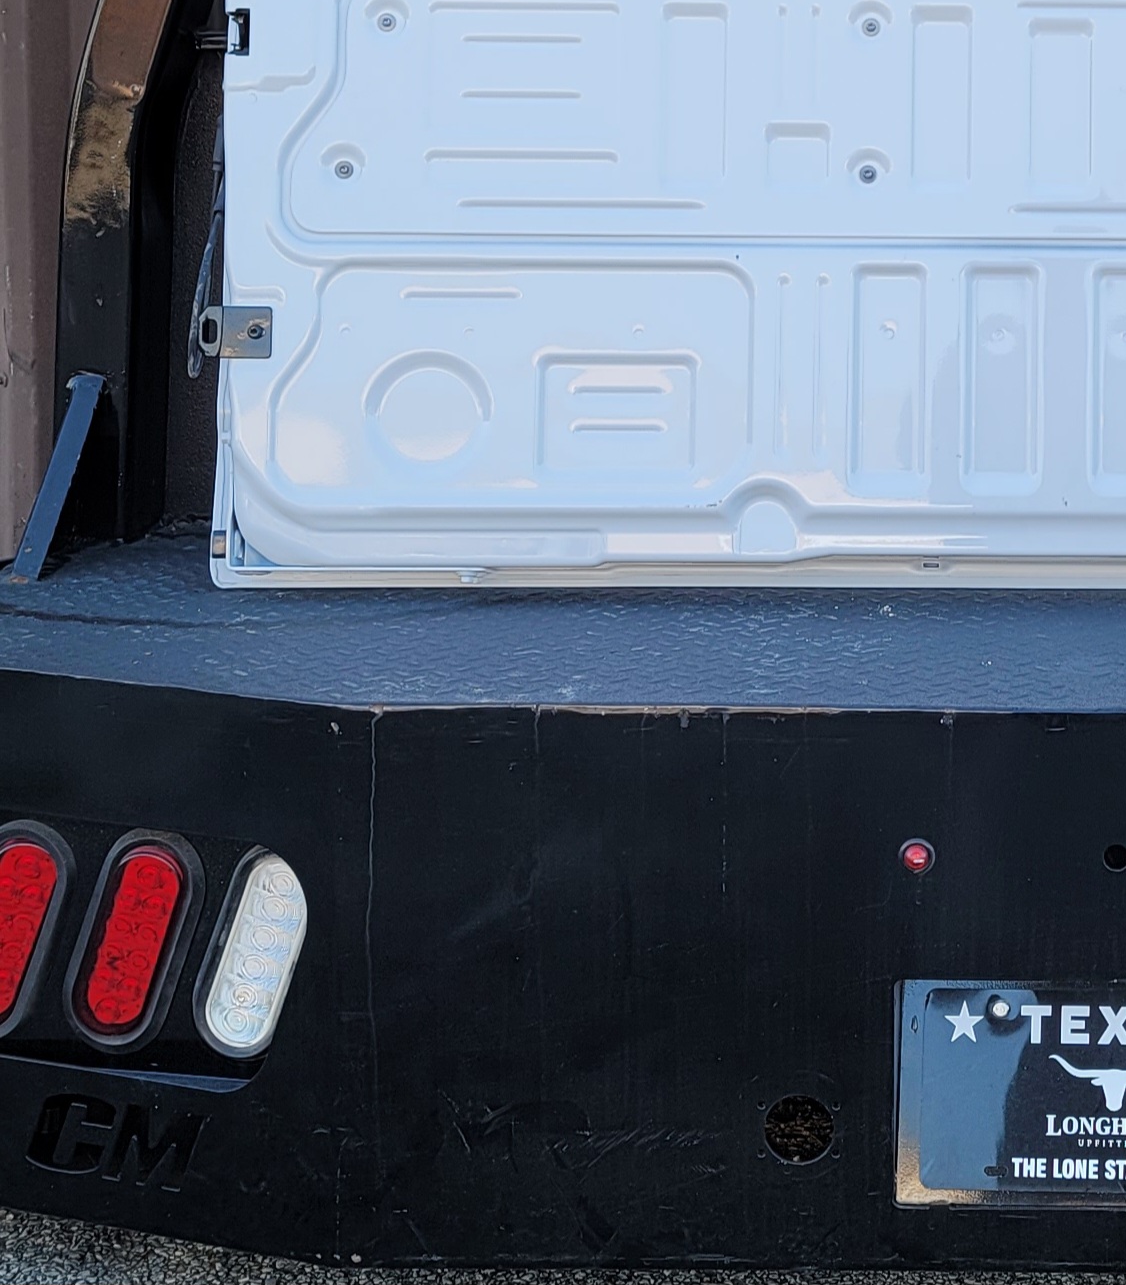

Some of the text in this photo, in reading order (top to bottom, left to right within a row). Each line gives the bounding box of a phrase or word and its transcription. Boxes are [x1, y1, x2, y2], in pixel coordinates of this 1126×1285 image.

[25, 1093, 212, 1192] CM
[1011, 1157, 1047, 1178] THE
[1052, 1158, 1099, 1180] LONE
